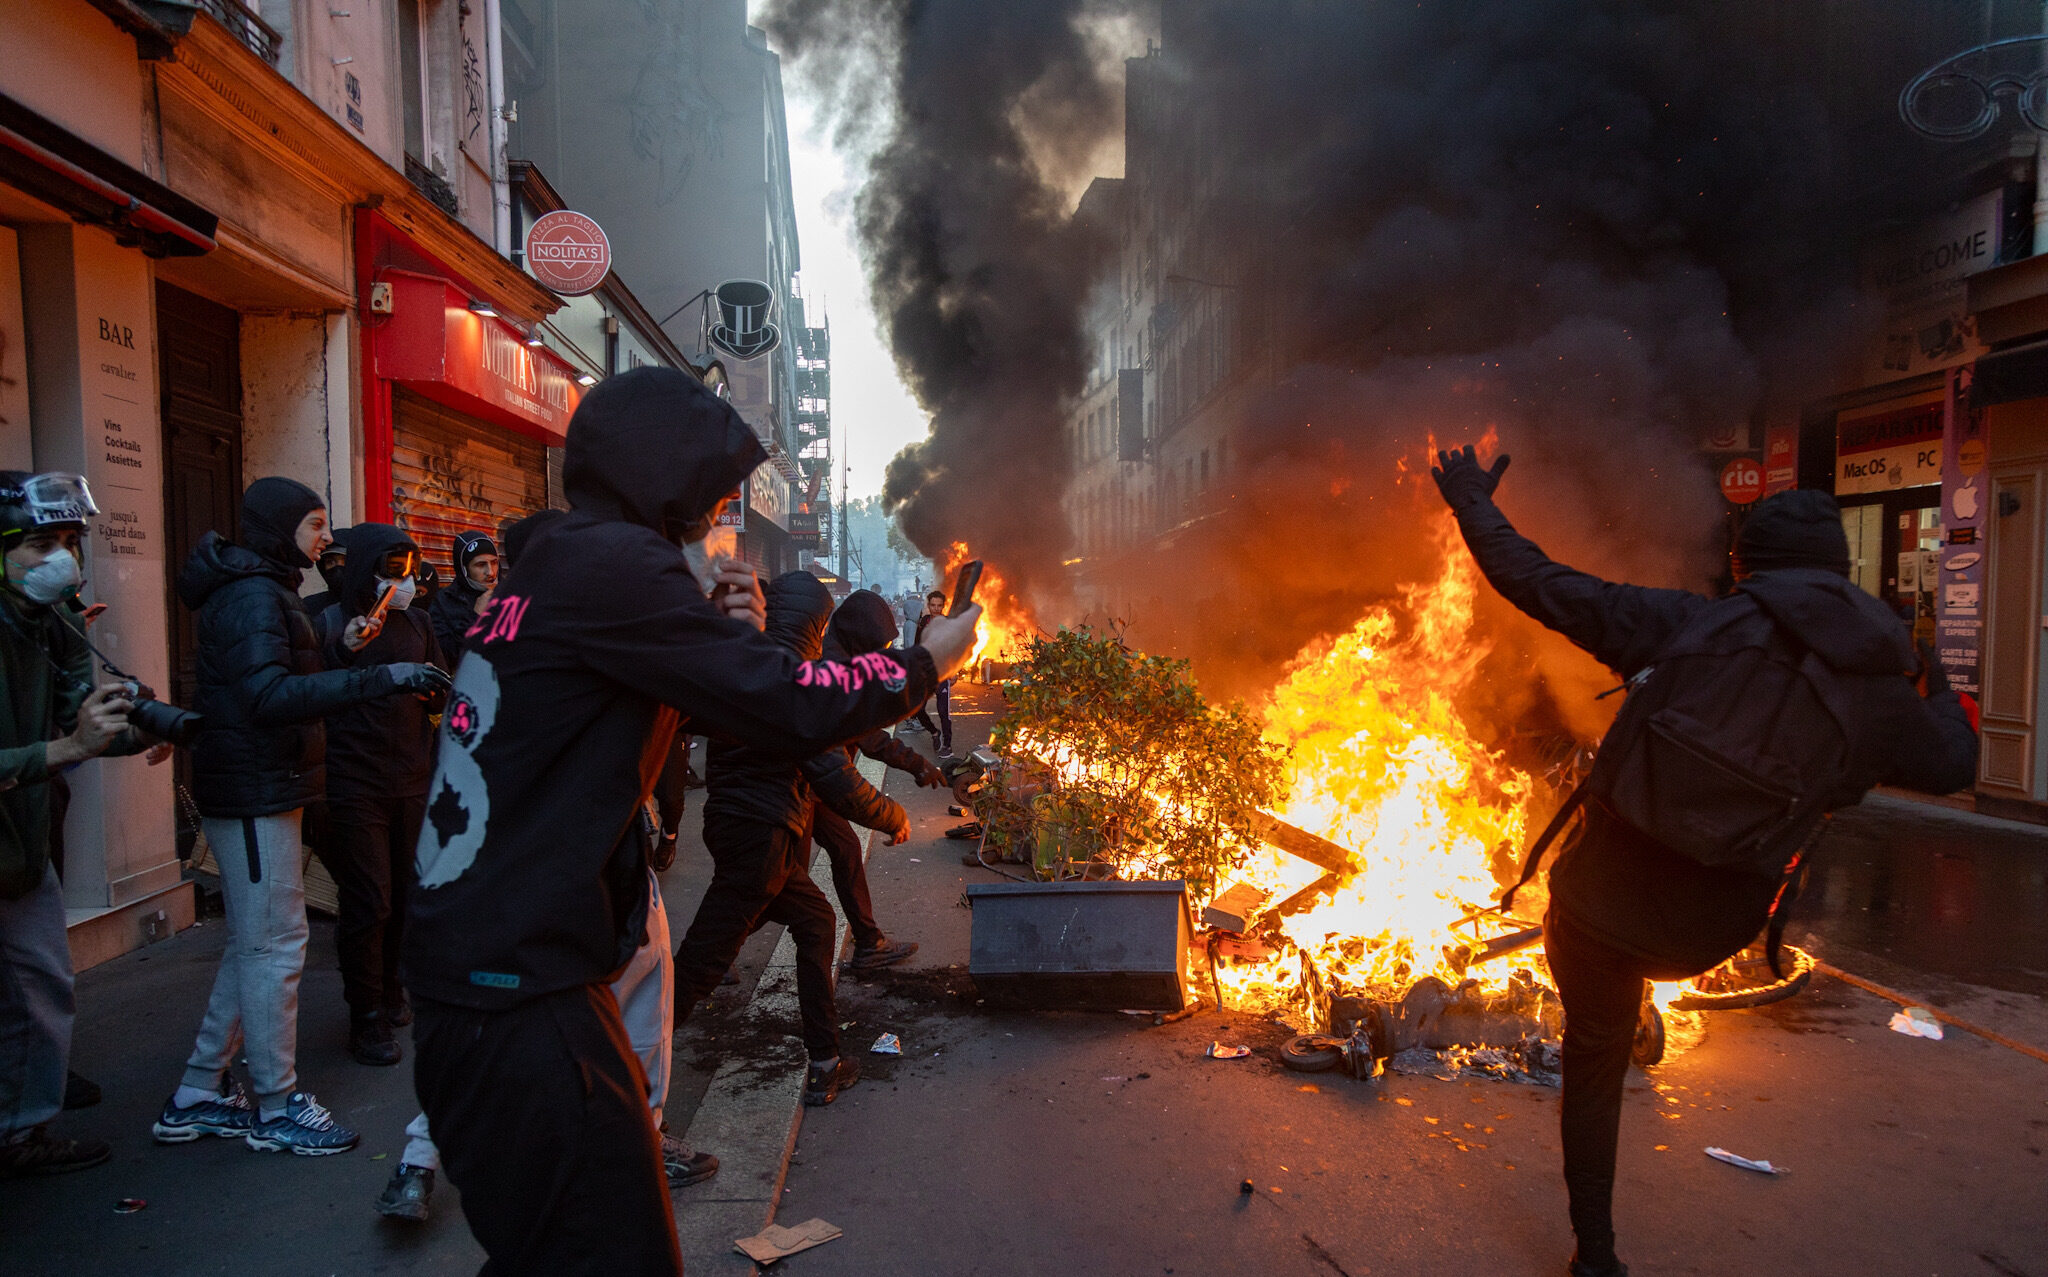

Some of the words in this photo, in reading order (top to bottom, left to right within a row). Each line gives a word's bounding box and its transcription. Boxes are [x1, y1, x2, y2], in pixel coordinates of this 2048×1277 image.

[532, 220, 554, 241] PIZZA
[558, 215, 568, 223] AL
[573, 215, 602, 242] TAGLIO
[537, 246, 598, 259] NOLITA'S
[536, 265, 557, 286] ITALIAN
[584, 268, 601, 285] FOOD
[98, 316, 135, 350] BAR
[482, 319, 537, 396] NOLITA'S
[504, 388, 523, 408] ITALIAN
[523, 398, 540, 416] STREET
[541, 407, 553, 422] FOOD
[104, 419, 121, 432] Vins
[105, 435, 141, 452] Cocktails
[106, 452, 142, 468] Assiettes
[1917, 450, 1936, 468] PC
[1725, 463, 1759, 486] ria
[721, 515, 731, 524] 99
[732, 515, 741, 524] 12
[128, 527, 146, 540] dans
[110, 541, 119, 554] la
[1945, 628, 1977, 636] EXPRESS
[1941, 648, 1963, 656] CARTE
[1964, 649, 1977, 657] SIM
